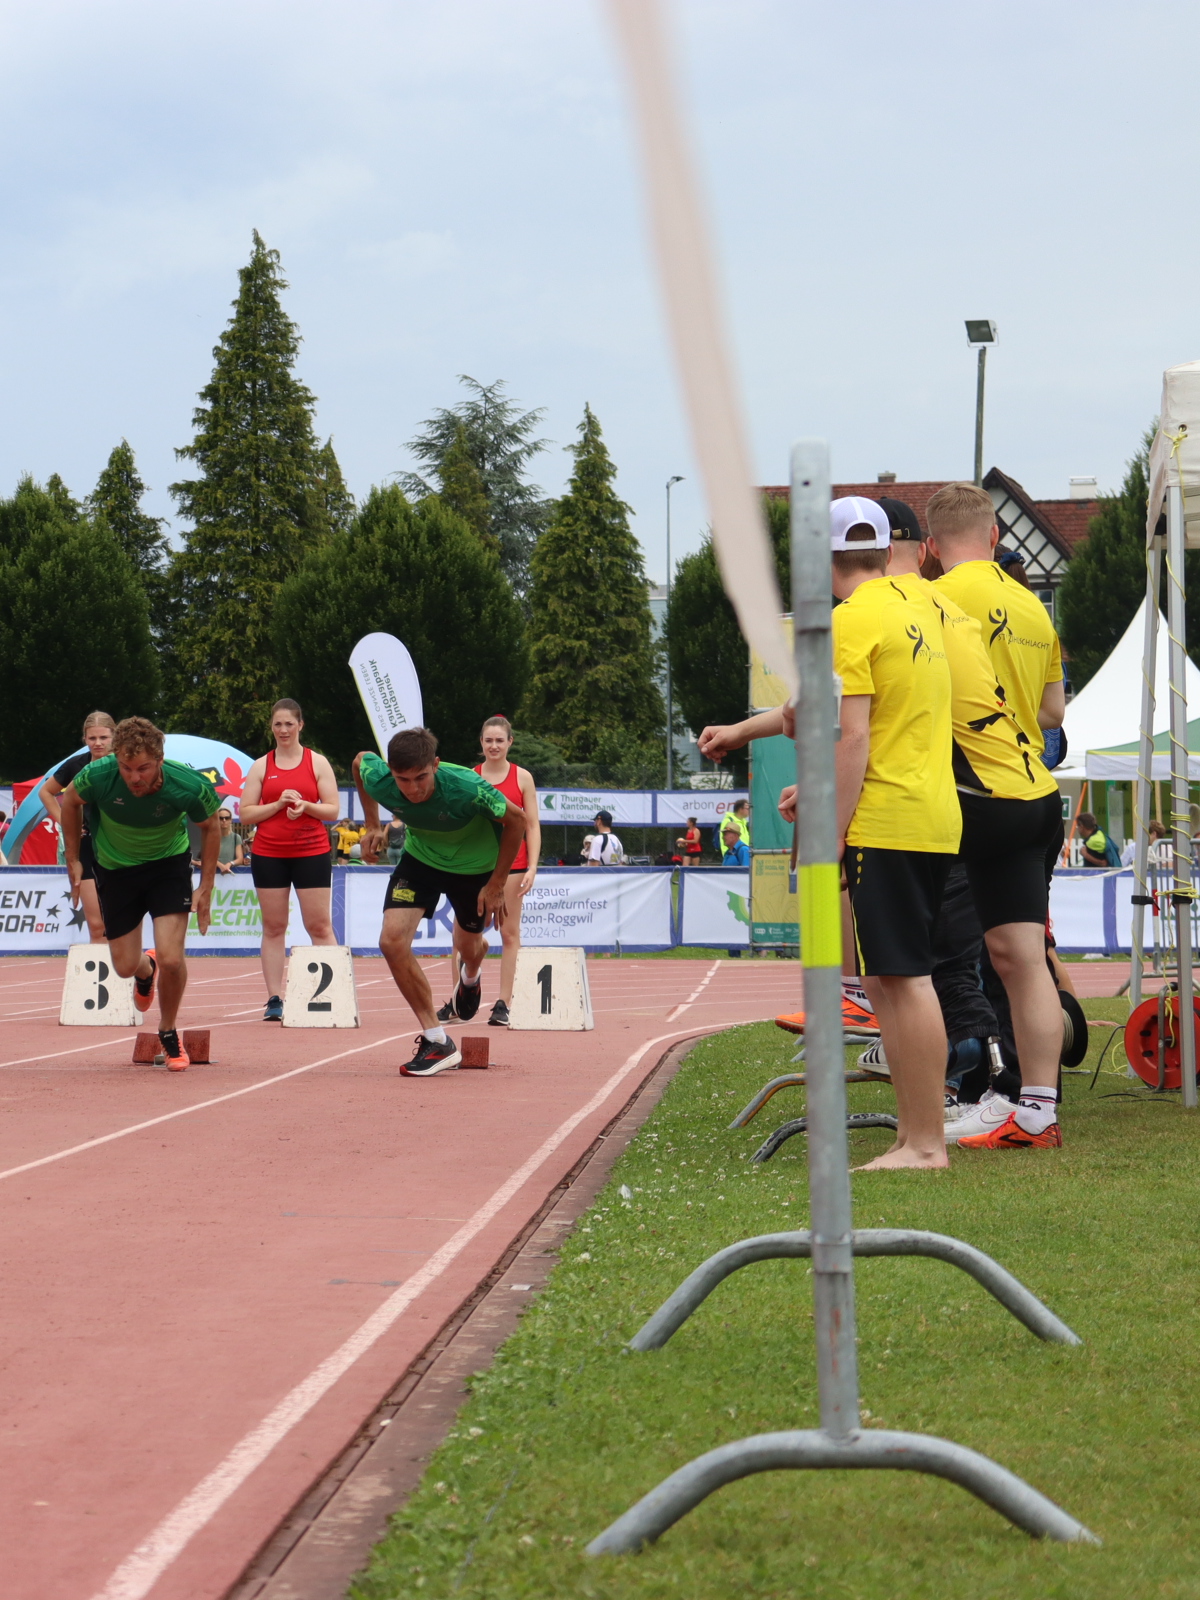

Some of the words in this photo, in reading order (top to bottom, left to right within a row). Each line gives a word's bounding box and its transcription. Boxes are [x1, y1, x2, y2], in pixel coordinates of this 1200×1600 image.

[561, 795, 602, 804] Thurgauer
[561, 803, 616, 811] Kantonalbank
[683, 800, 714, 810] arbon
[521, 899, 608, 910] antonalturnfest
[84, 961, 109, 1010] 3
[307, 962, 333, 1012] 2
[537, 964, 553, 1014] 1
[845, 989, 867, 999] FIL
[1019, 1101, 1042, 1110] ILA
